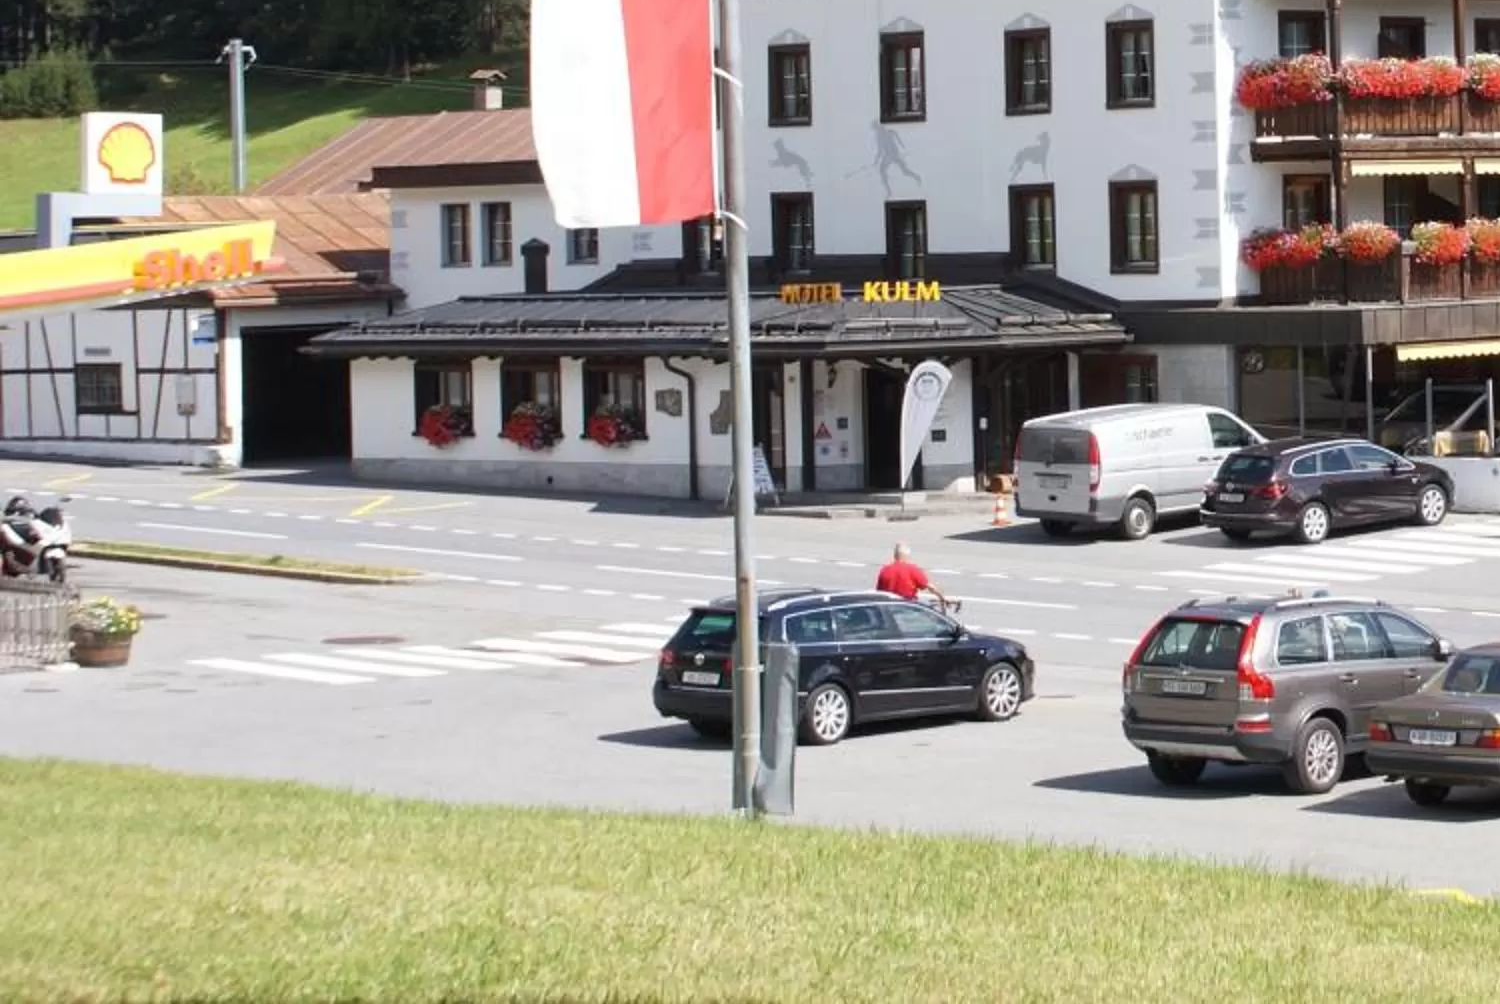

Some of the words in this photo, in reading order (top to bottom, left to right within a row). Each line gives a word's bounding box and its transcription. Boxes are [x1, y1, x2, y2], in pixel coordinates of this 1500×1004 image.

[133, 239, 253, 290] Shell
[779, 282, 841, 303] HOTEL
[864, 281, 941, 302] KULM
